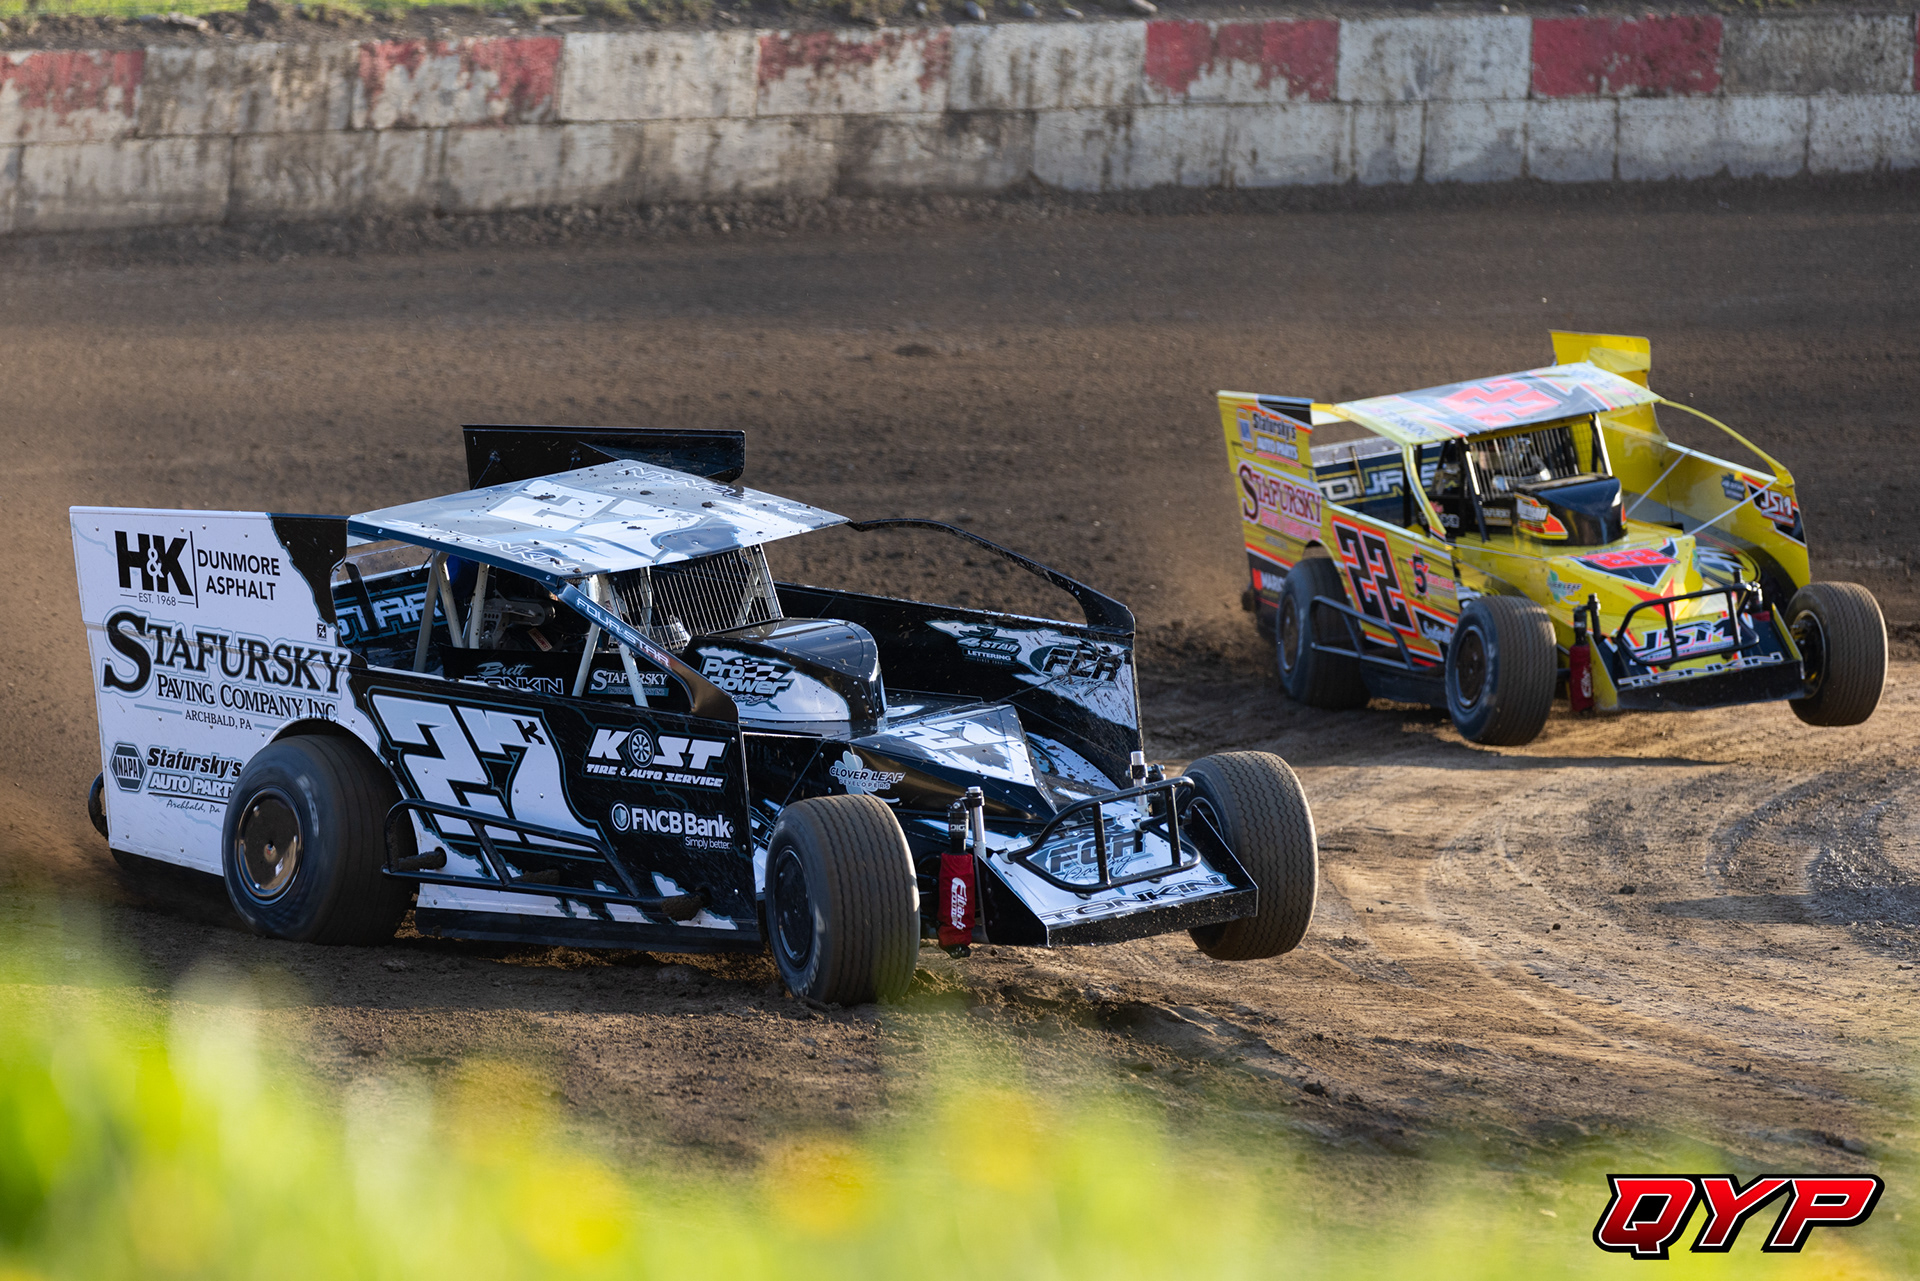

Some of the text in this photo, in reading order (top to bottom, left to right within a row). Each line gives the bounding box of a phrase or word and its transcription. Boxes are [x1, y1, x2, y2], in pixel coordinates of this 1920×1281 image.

[1239, 464, 1322, 523] STAFURSKY
[114, 530, 194, 597] H&K
[197, 548, 281, 577] DUNMORE
[1413, 555, 1427, 593] 5
[205, 574, 276, 601] ASPHALT
[1333, 523, 1415, 633] 22
[138, 592, 177, 607] EST. 1968
[576, 597, 670, 667] FOUR STAR
[102, 612, 349, 695] STAFURSKY
[967, 649, 1012, 662] LETTERING
[477, 661, 532, 677] Brett
[590, 669, 668, 691] STAFRSKY
[702, 658, 745, 679] Pro
[157, 673, 216, 706] PAVING
[220, 683, 303, 721] COMPANY
[185, 709, 252, 731] ARCHBALD, PA
[117, 755, 140, 779] NAPA
[147, 748, 243, 779] Stafursky's
[586, 764, 724, 788] TIRE & AUTO SERVICE
[829, 767, 906, 784] CLOVER LEAF
[150, 772, 191, 794] AUTO
[838, 778, 891, 790] DEVELOPERS
[631, 807, 684, 834] FNCB
[685, 837, 709, 850] Simply
[1040, 873, 1229, 921] TONKIN
